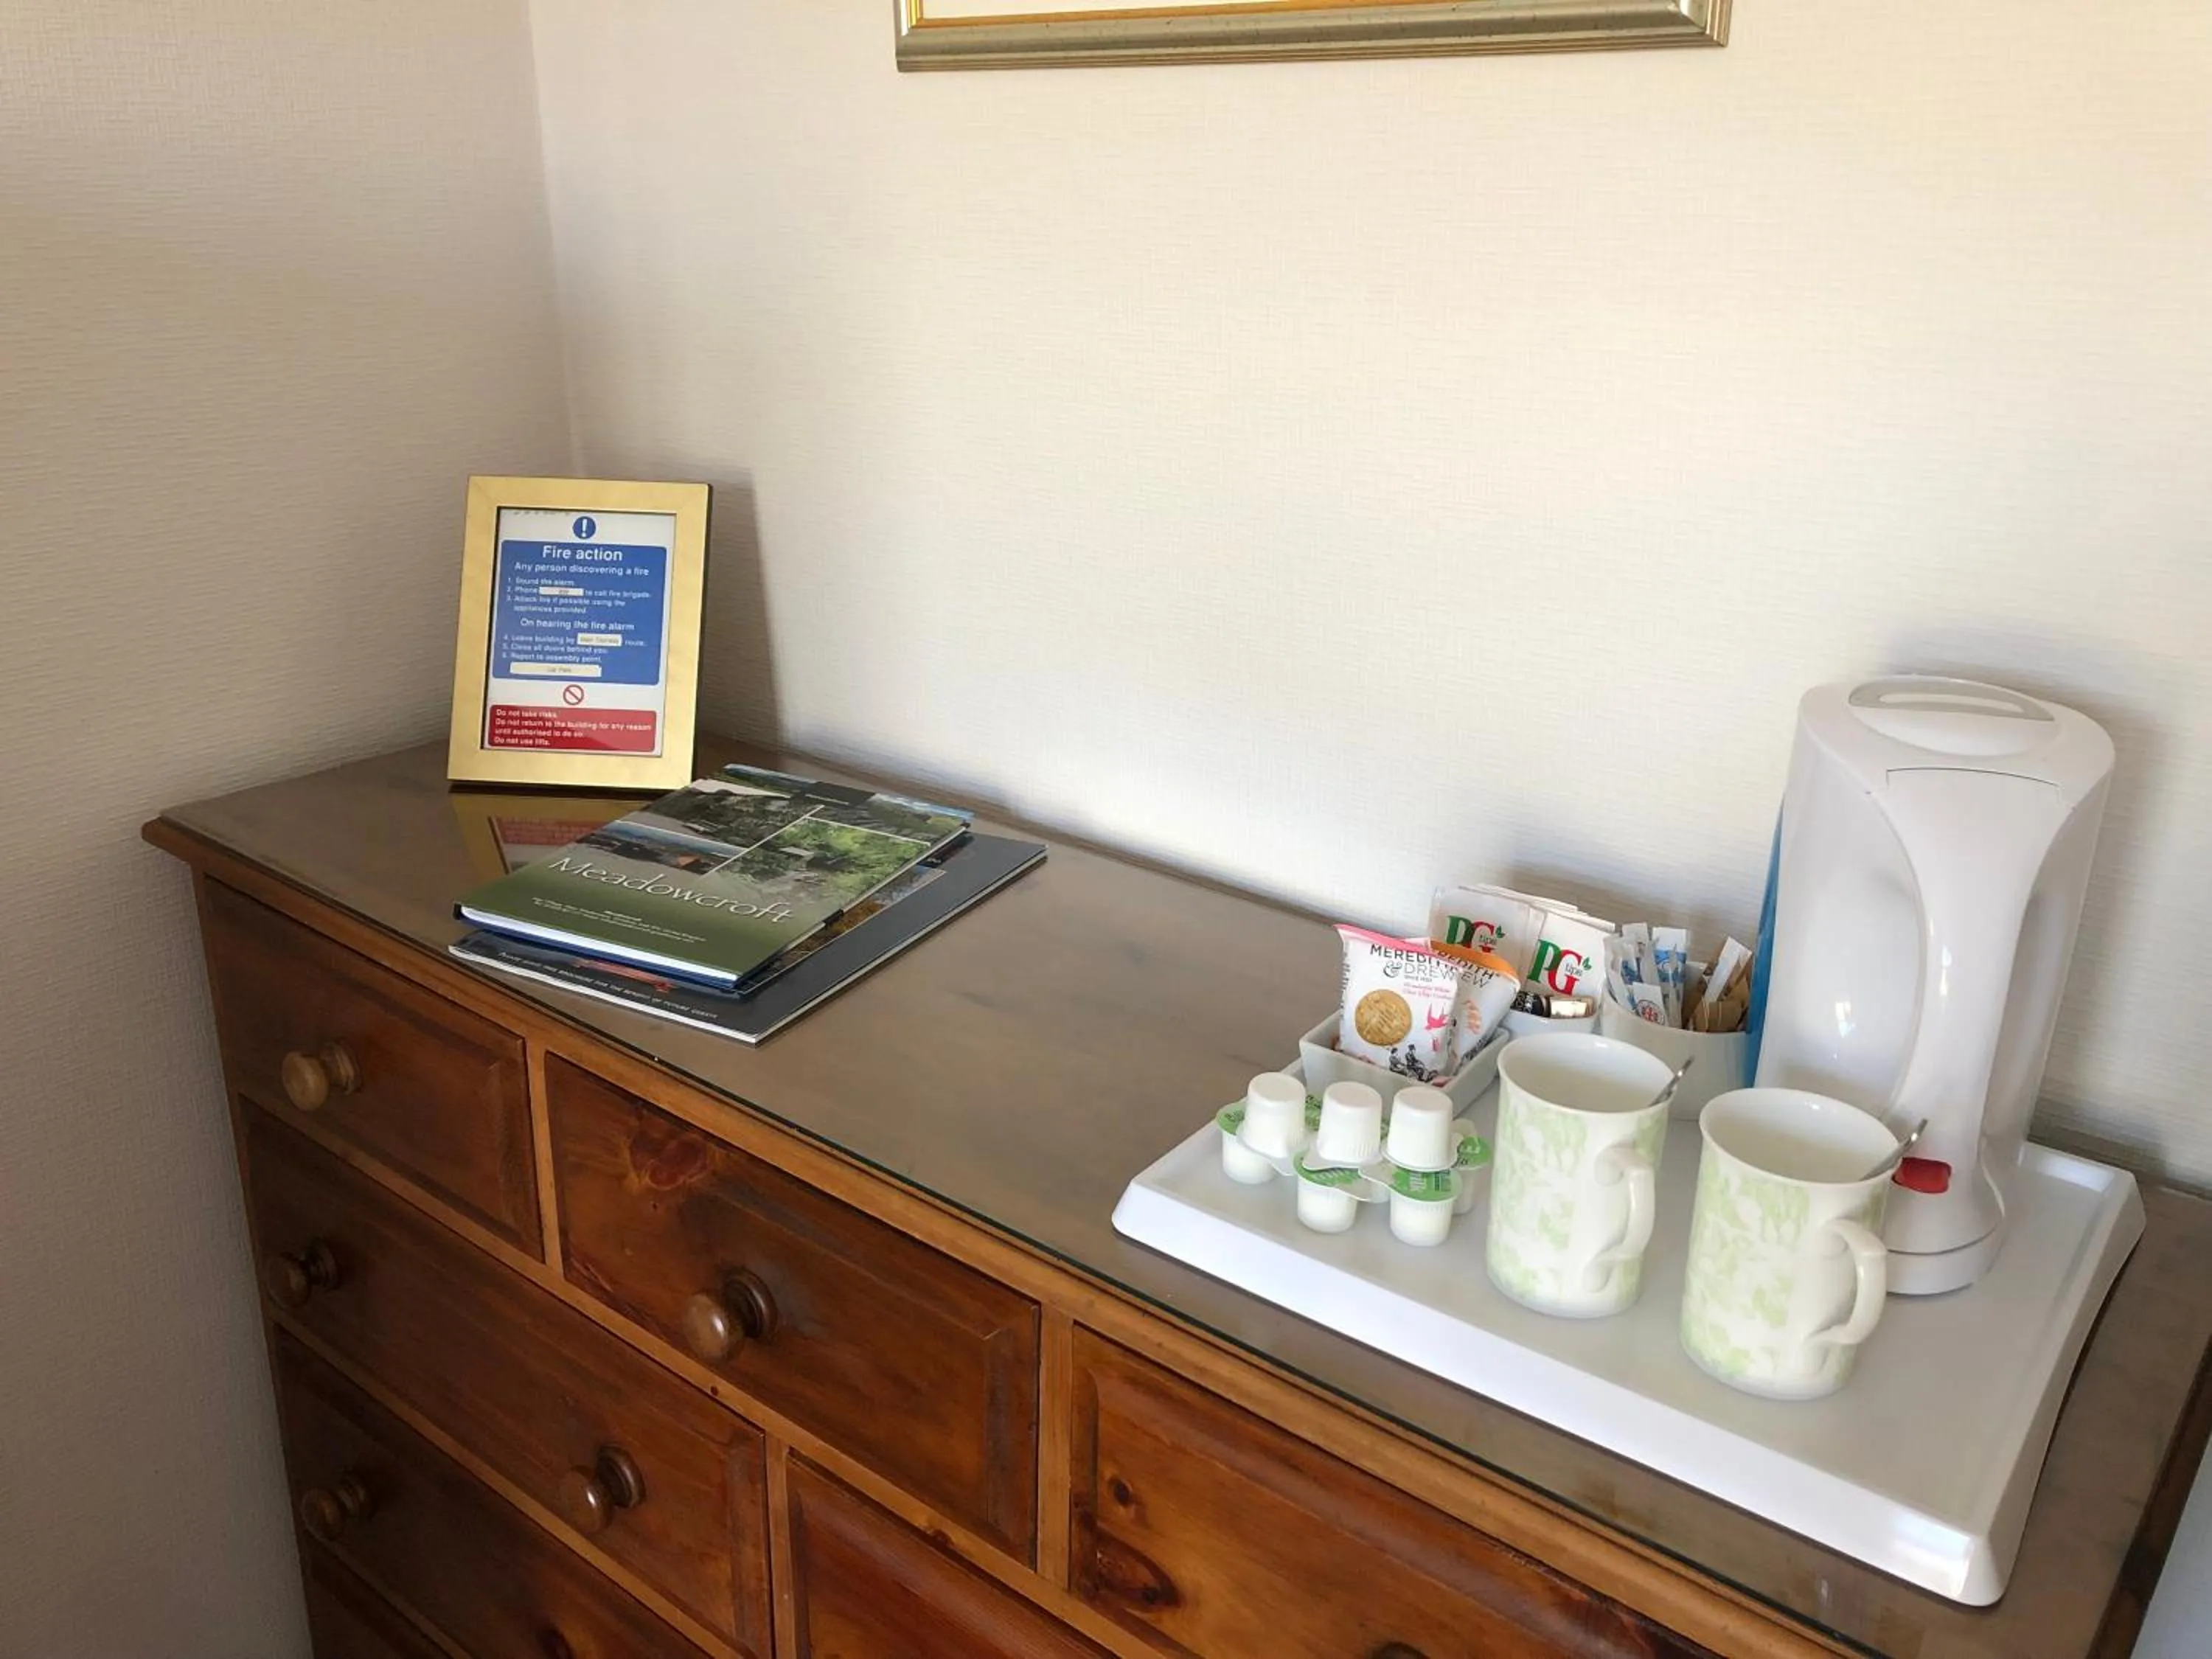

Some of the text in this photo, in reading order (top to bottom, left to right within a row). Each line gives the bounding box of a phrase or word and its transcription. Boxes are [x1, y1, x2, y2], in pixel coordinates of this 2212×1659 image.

[542, 545, 623, 561] Fire action
[515, 562, 532, 571] Any
[535, 564, 567, 574] person
[568, 564, 624, 576] discovering
[633, 567, 650, 576] fire
[520, 617, 635, 630] On hearing the fire alarm
[495, 709, 507, 717] Do
[508, 709, 520, 717] not
[521, 710, 538, 718] take
[495, 717, 506, 726] Do
[507, 718, 520, 726] not
[493, 736, 504, 744] Do
[548, 856, 793, 923] Meadowcroft
[1447, 914, 1495, 953] PG
[1404, 961, 1456, 981] DREW
[1526, 938, 1584, 996] PG
